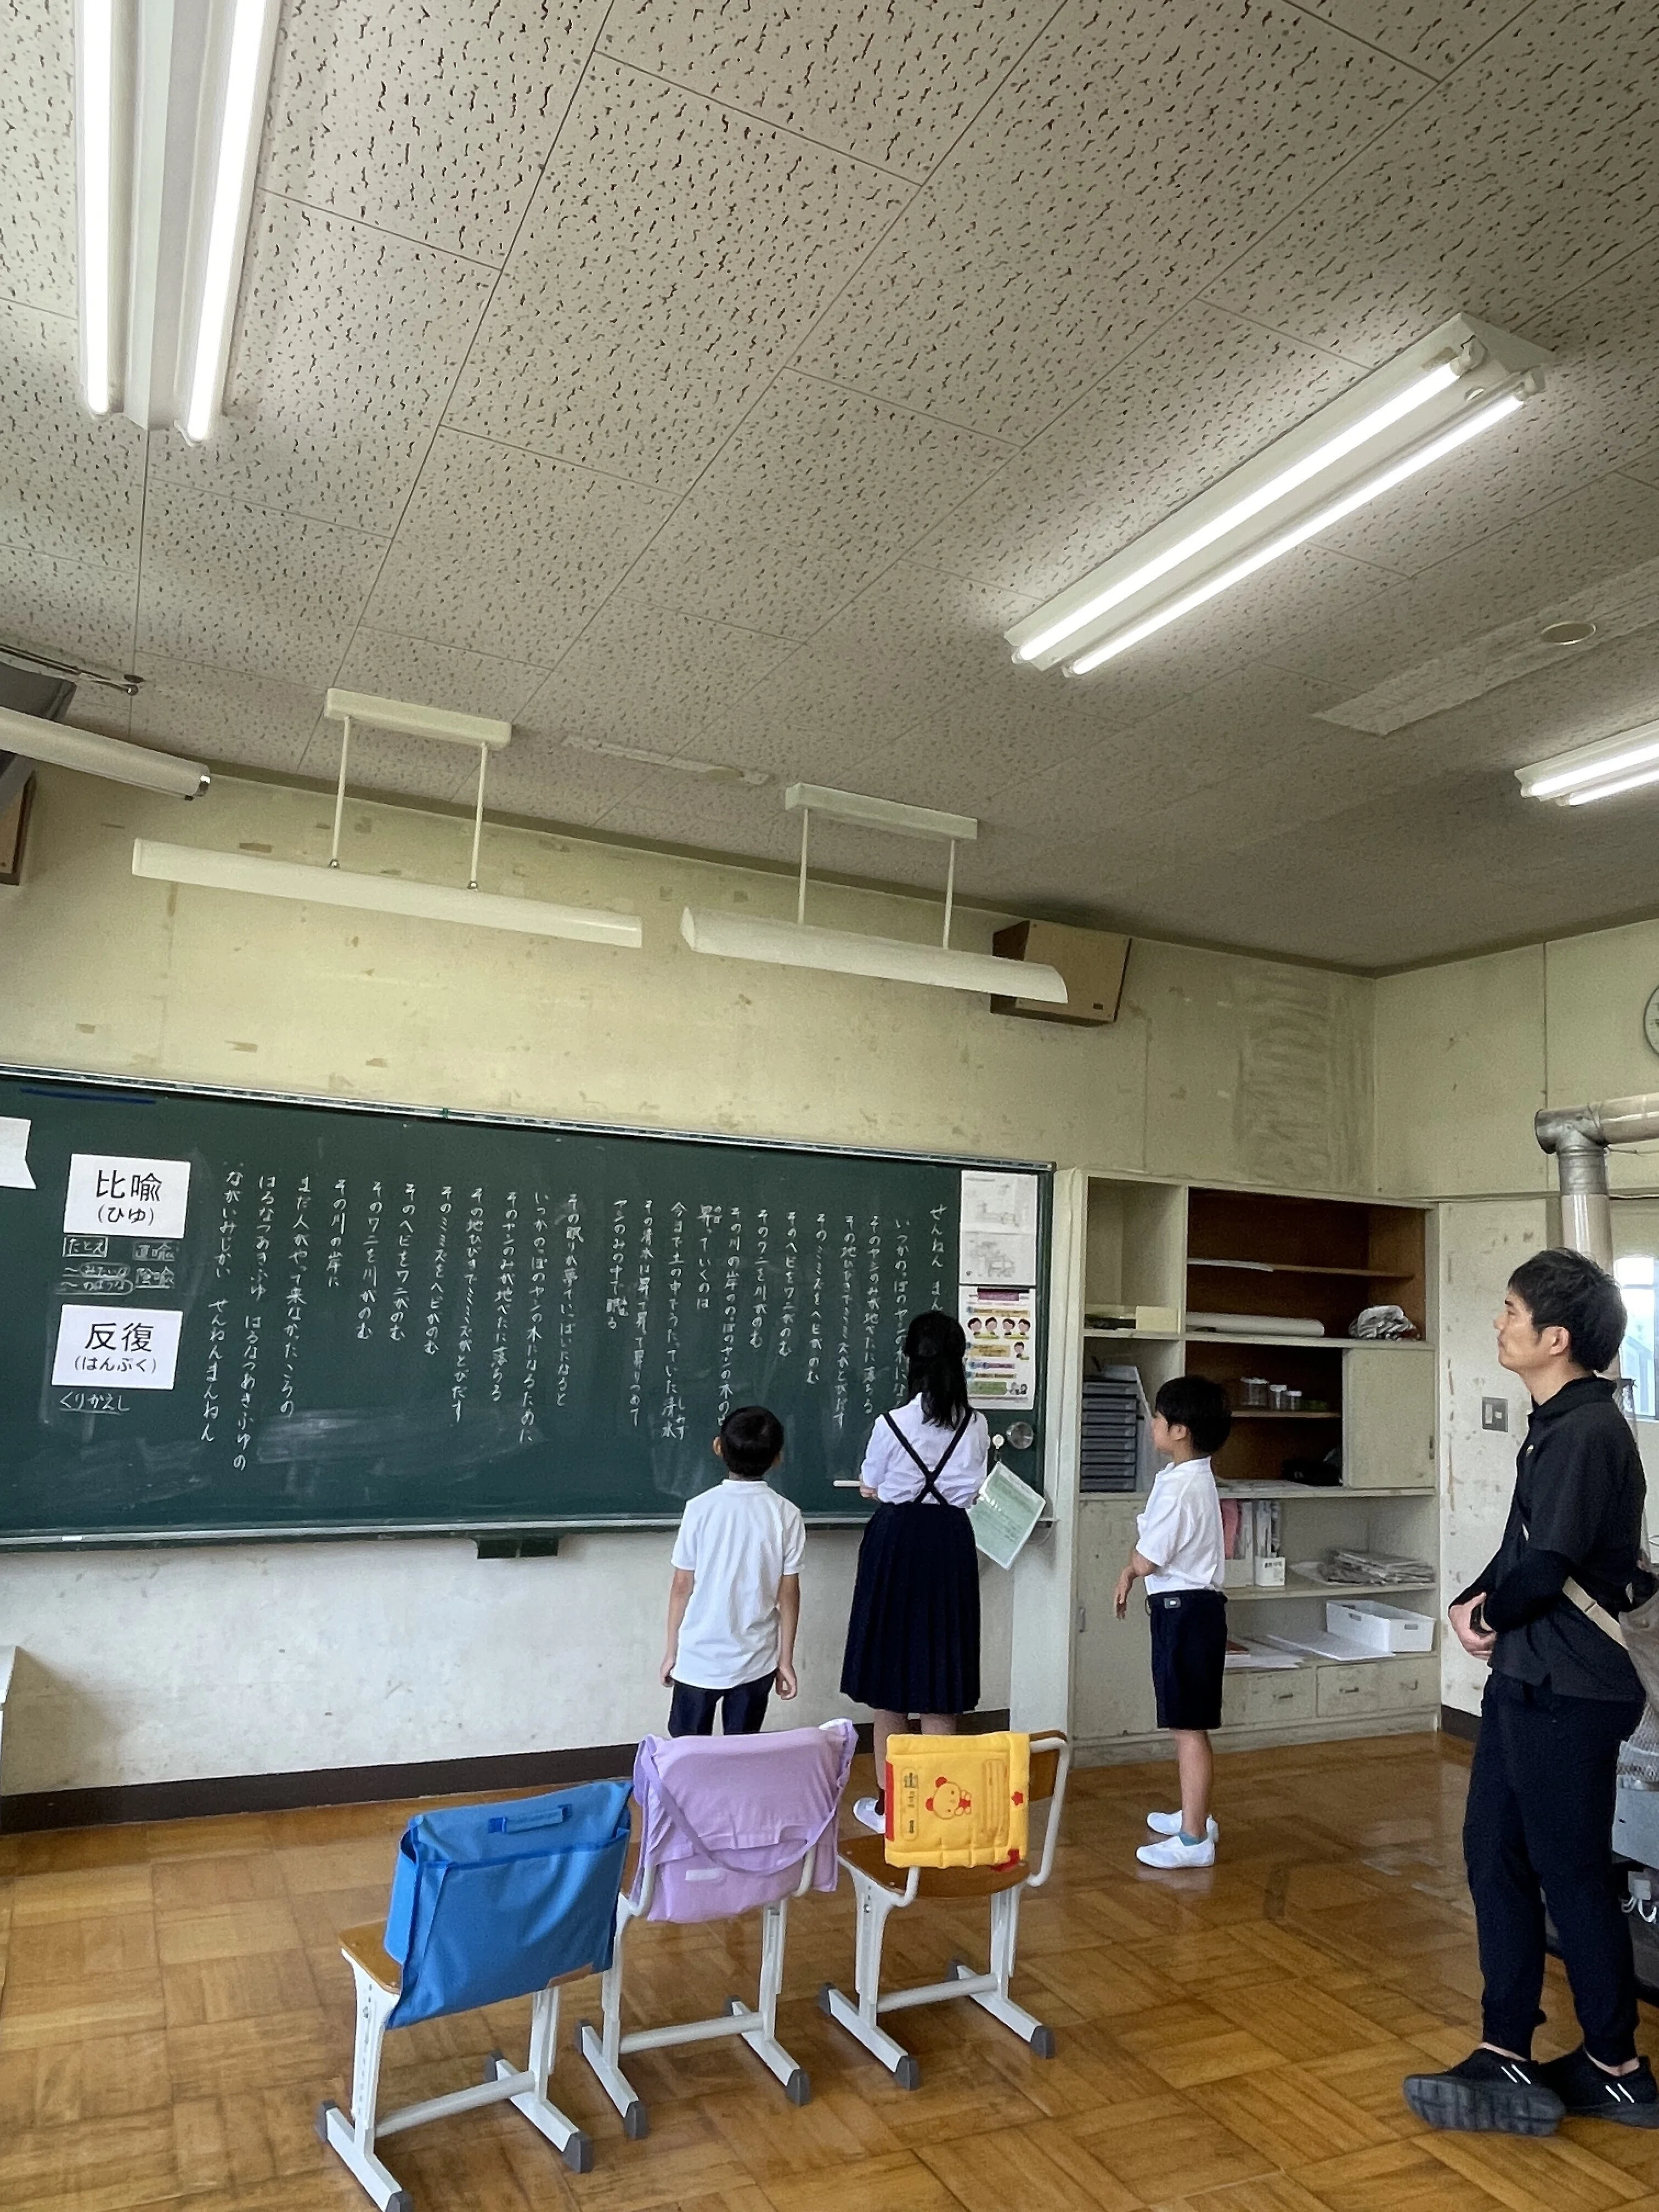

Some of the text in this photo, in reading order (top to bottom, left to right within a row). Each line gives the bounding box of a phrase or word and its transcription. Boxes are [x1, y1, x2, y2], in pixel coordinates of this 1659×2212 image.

[96, 1170, 162, 1201] 比喩
[98, 1204, 154, 1226] （ひゆ）
[69, 1238, 106, 1255] たとえ
[84, 1322, 154, 1352] 反復
[75, 1355, 157, 1374] （はんぶく）
[59, 1391, 131, 1411] くりかえし
